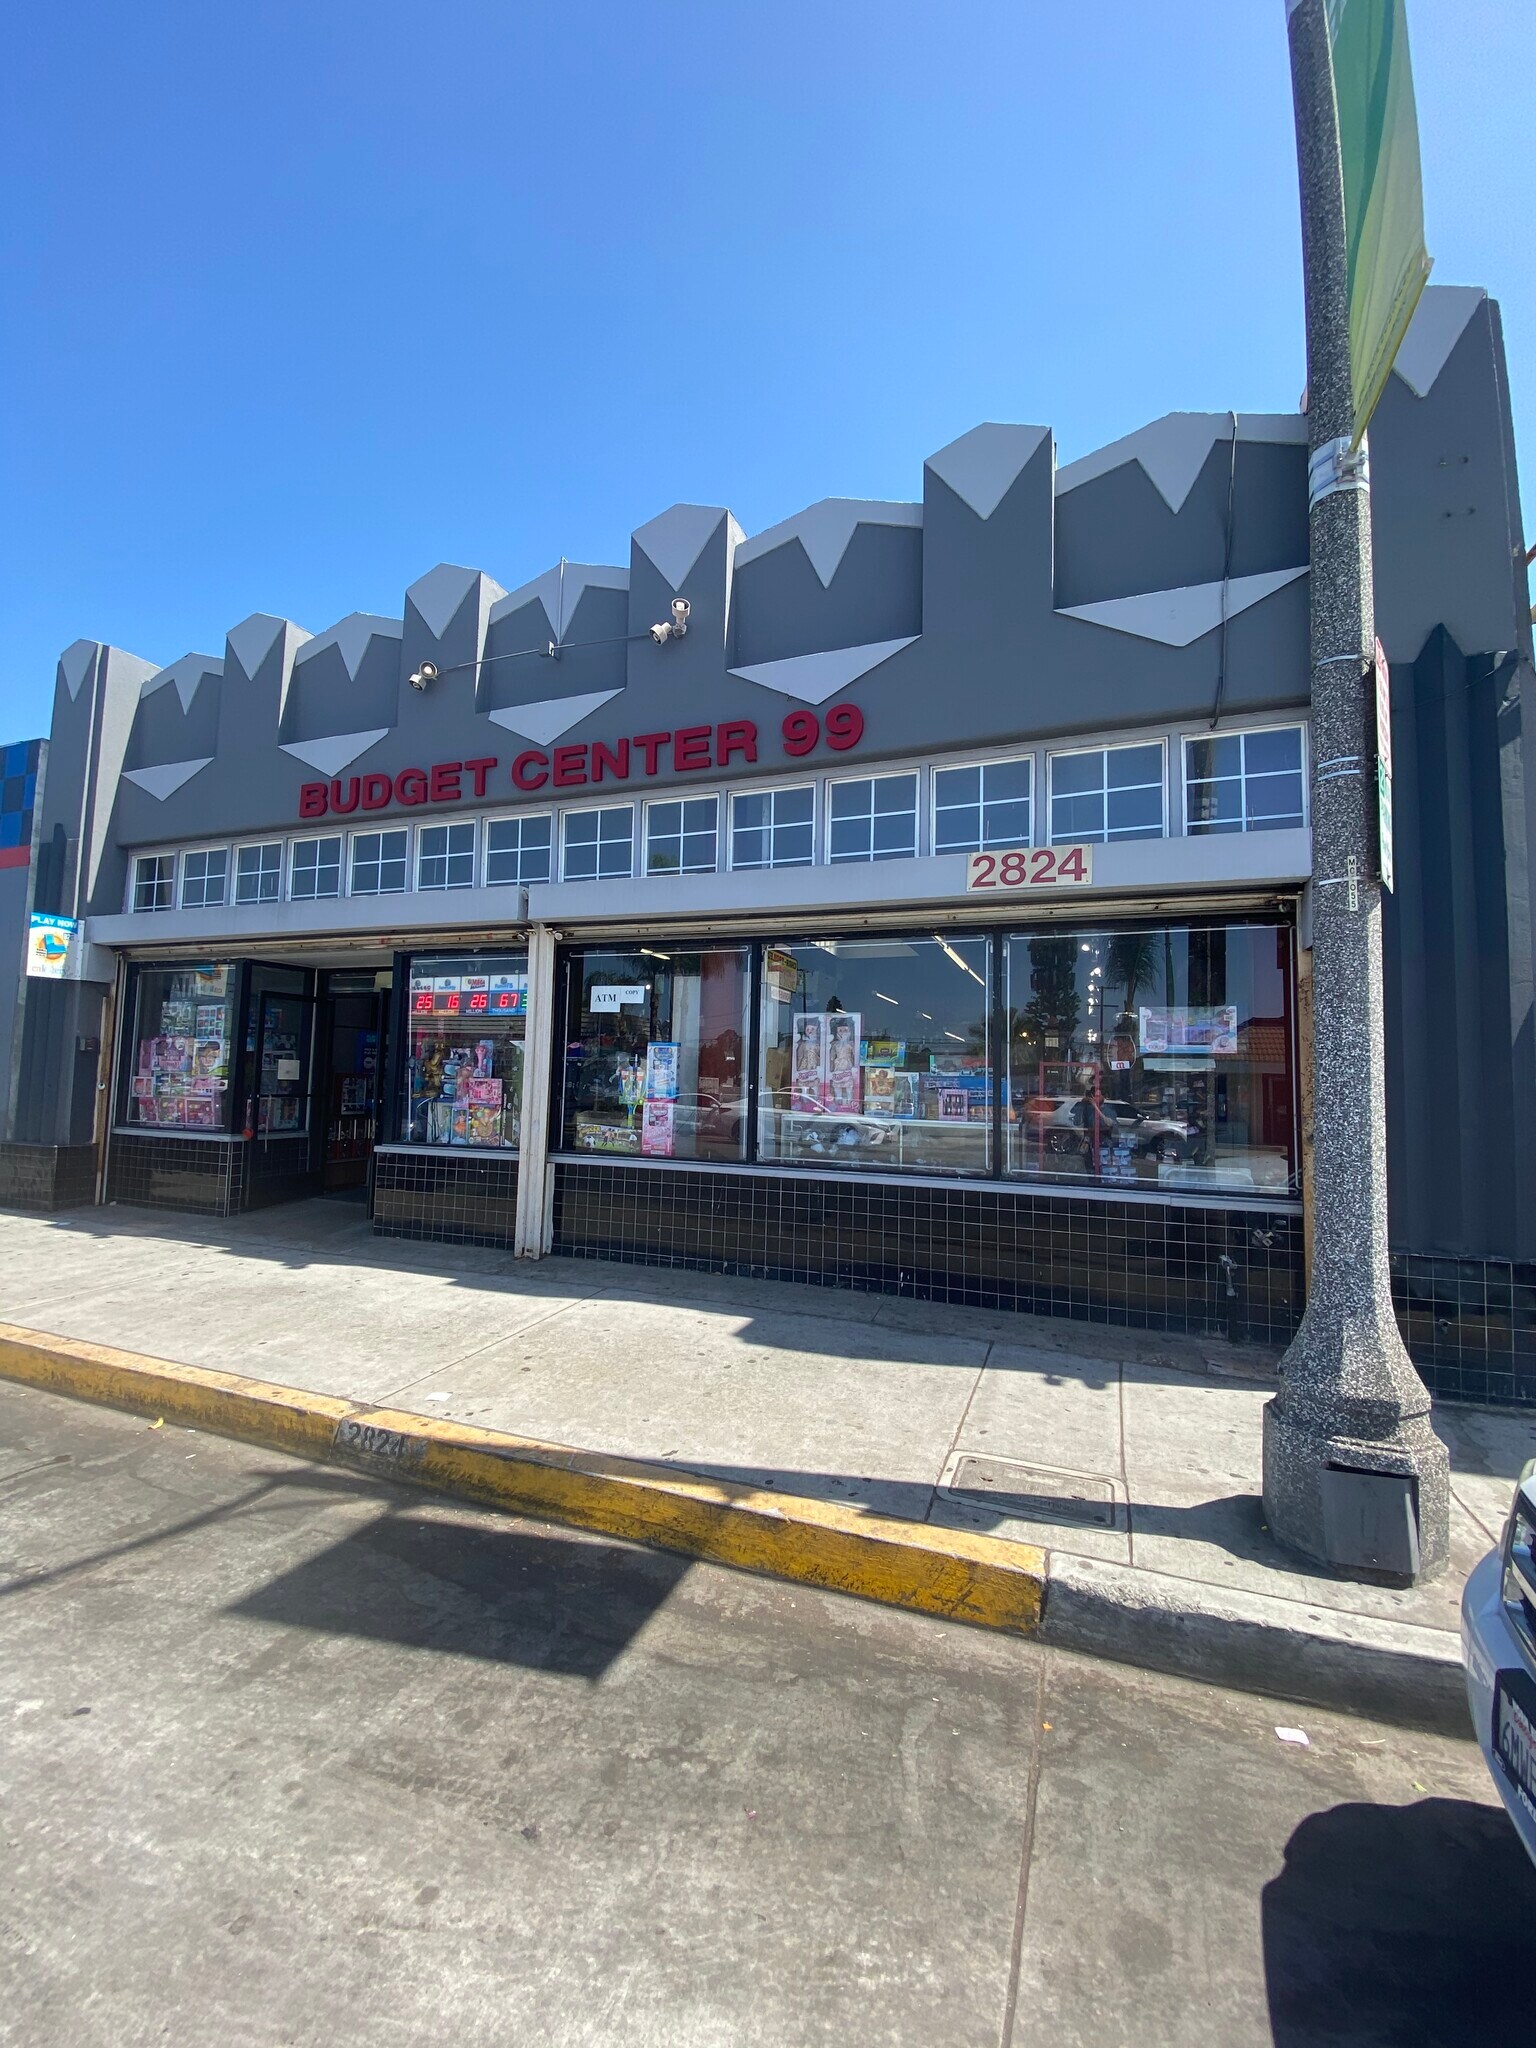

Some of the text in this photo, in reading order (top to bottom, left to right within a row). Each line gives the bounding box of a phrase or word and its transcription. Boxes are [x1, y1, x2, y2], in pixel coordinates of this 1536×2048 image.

[299, 703, 864, 817] BUDGET CENTER 99
[972, 848, 1087, 888] 2824
[31, 914, 77, 928] PLAY NOW
[416, 995, 433, 1009] 25
[447, 995, 460, 1008] 16
[470, 994, 487, 1008] 26
[499, 993, 518, 1007] 67
[595, 994, 616, 1002] ATM
[347, 1421, 406, 1458] 2824
